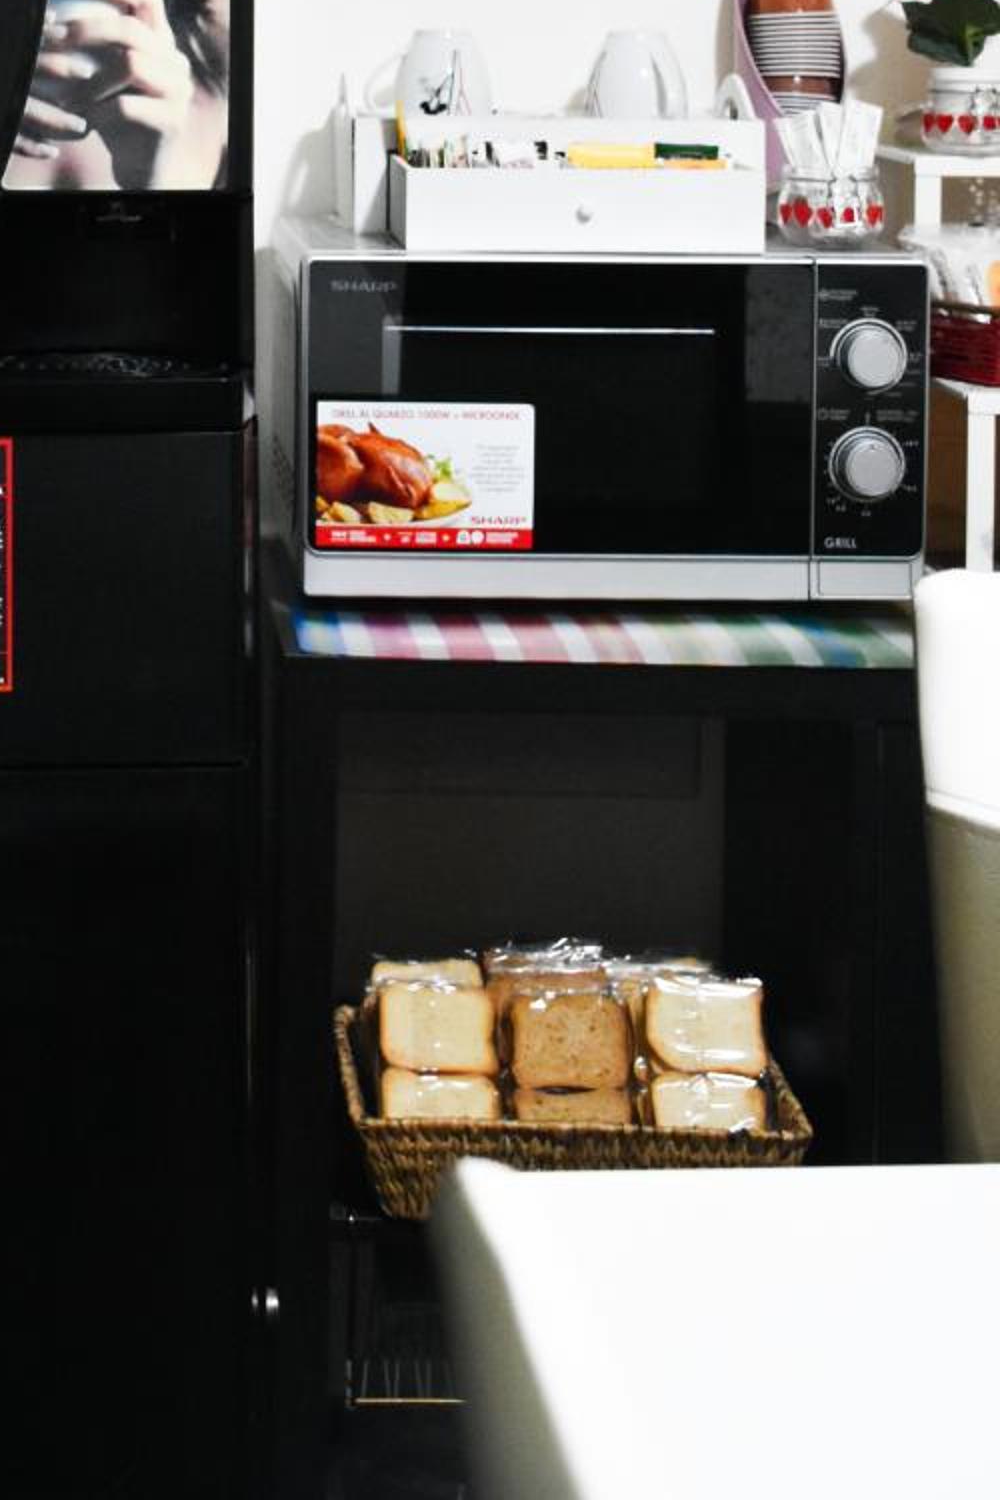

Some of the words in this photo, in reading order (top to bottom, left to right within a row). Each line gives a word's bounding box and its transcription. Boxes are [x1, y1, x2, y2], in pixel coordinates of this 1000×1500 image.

[330, 280, 398, 292] SHARP
[462, 409, 520, 420] MICROONDE
[471, 515, 527, 525] SHARP
[824, 537, 856, 549] GRILL
